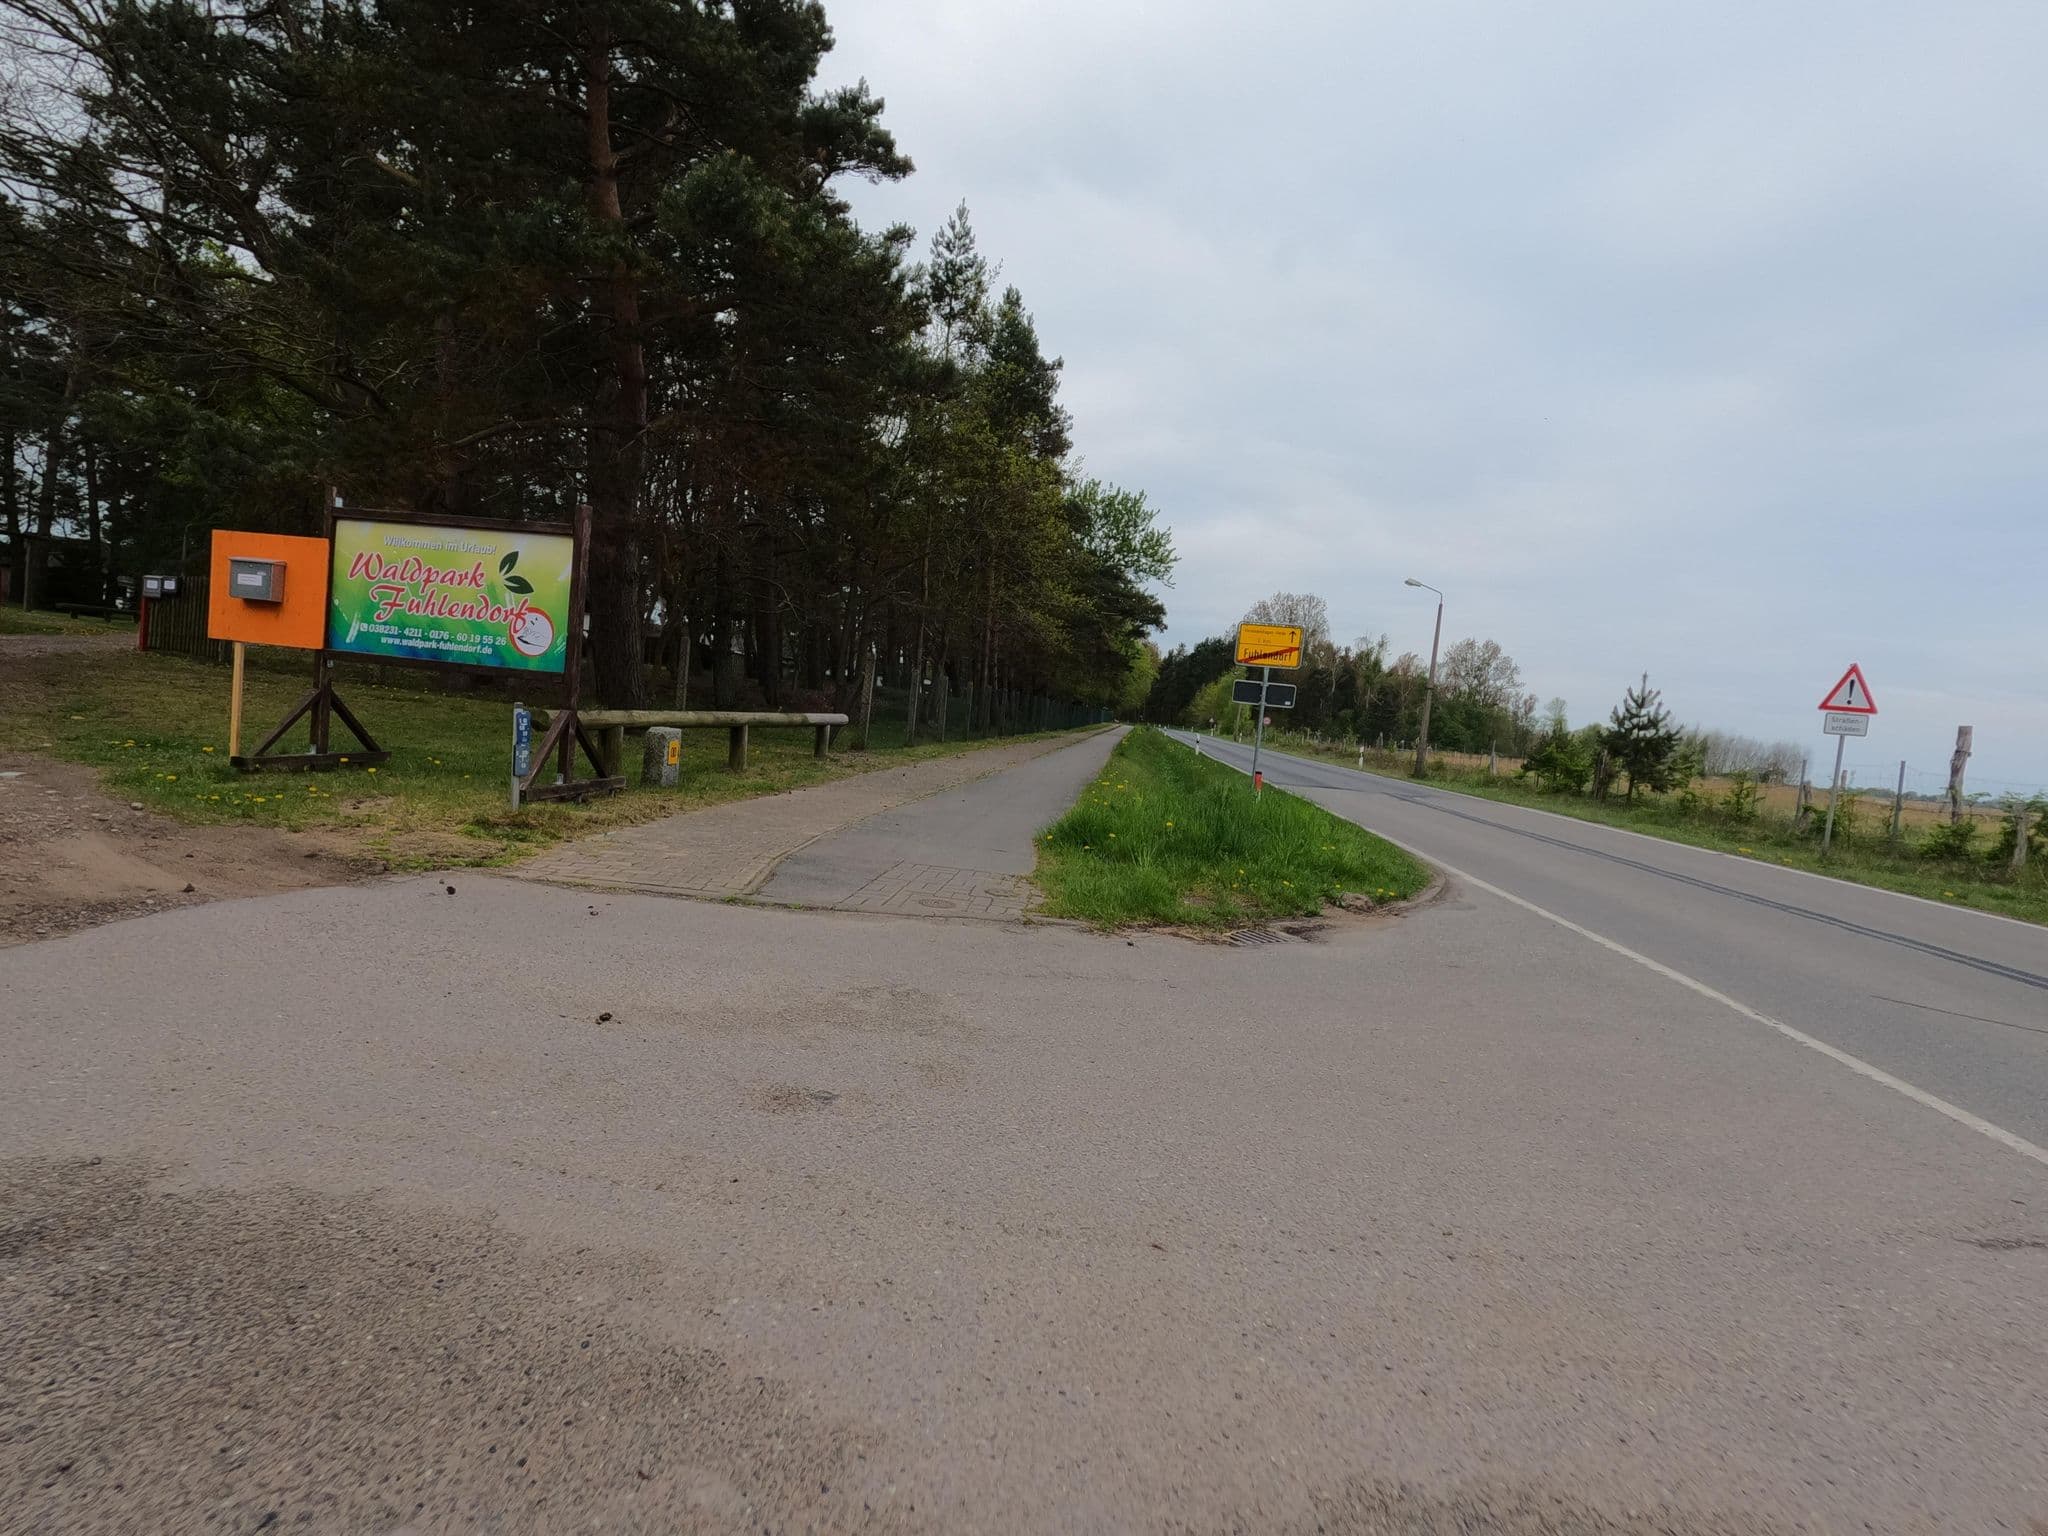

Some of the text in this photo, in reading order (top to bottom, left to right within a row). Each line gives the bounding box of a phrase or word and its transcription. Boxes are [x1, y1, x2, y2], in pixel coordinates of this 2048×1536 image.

[383, 535, 497, 555] Willkommen im Urlaub!
[349, 551, 485, 593] Waldpark
[370, 584, 529, 633] Fuhlendorf
[380, 636, 493, 655] www.waldpark-fuhlendorf.de
[403, 627, 422, 638] 4211
[429, 630, 449, 640] 0176
[456, 632, 468, 642] 60
[469, 633, 481, 643] 19
[483, 635, 493, 645] 55
